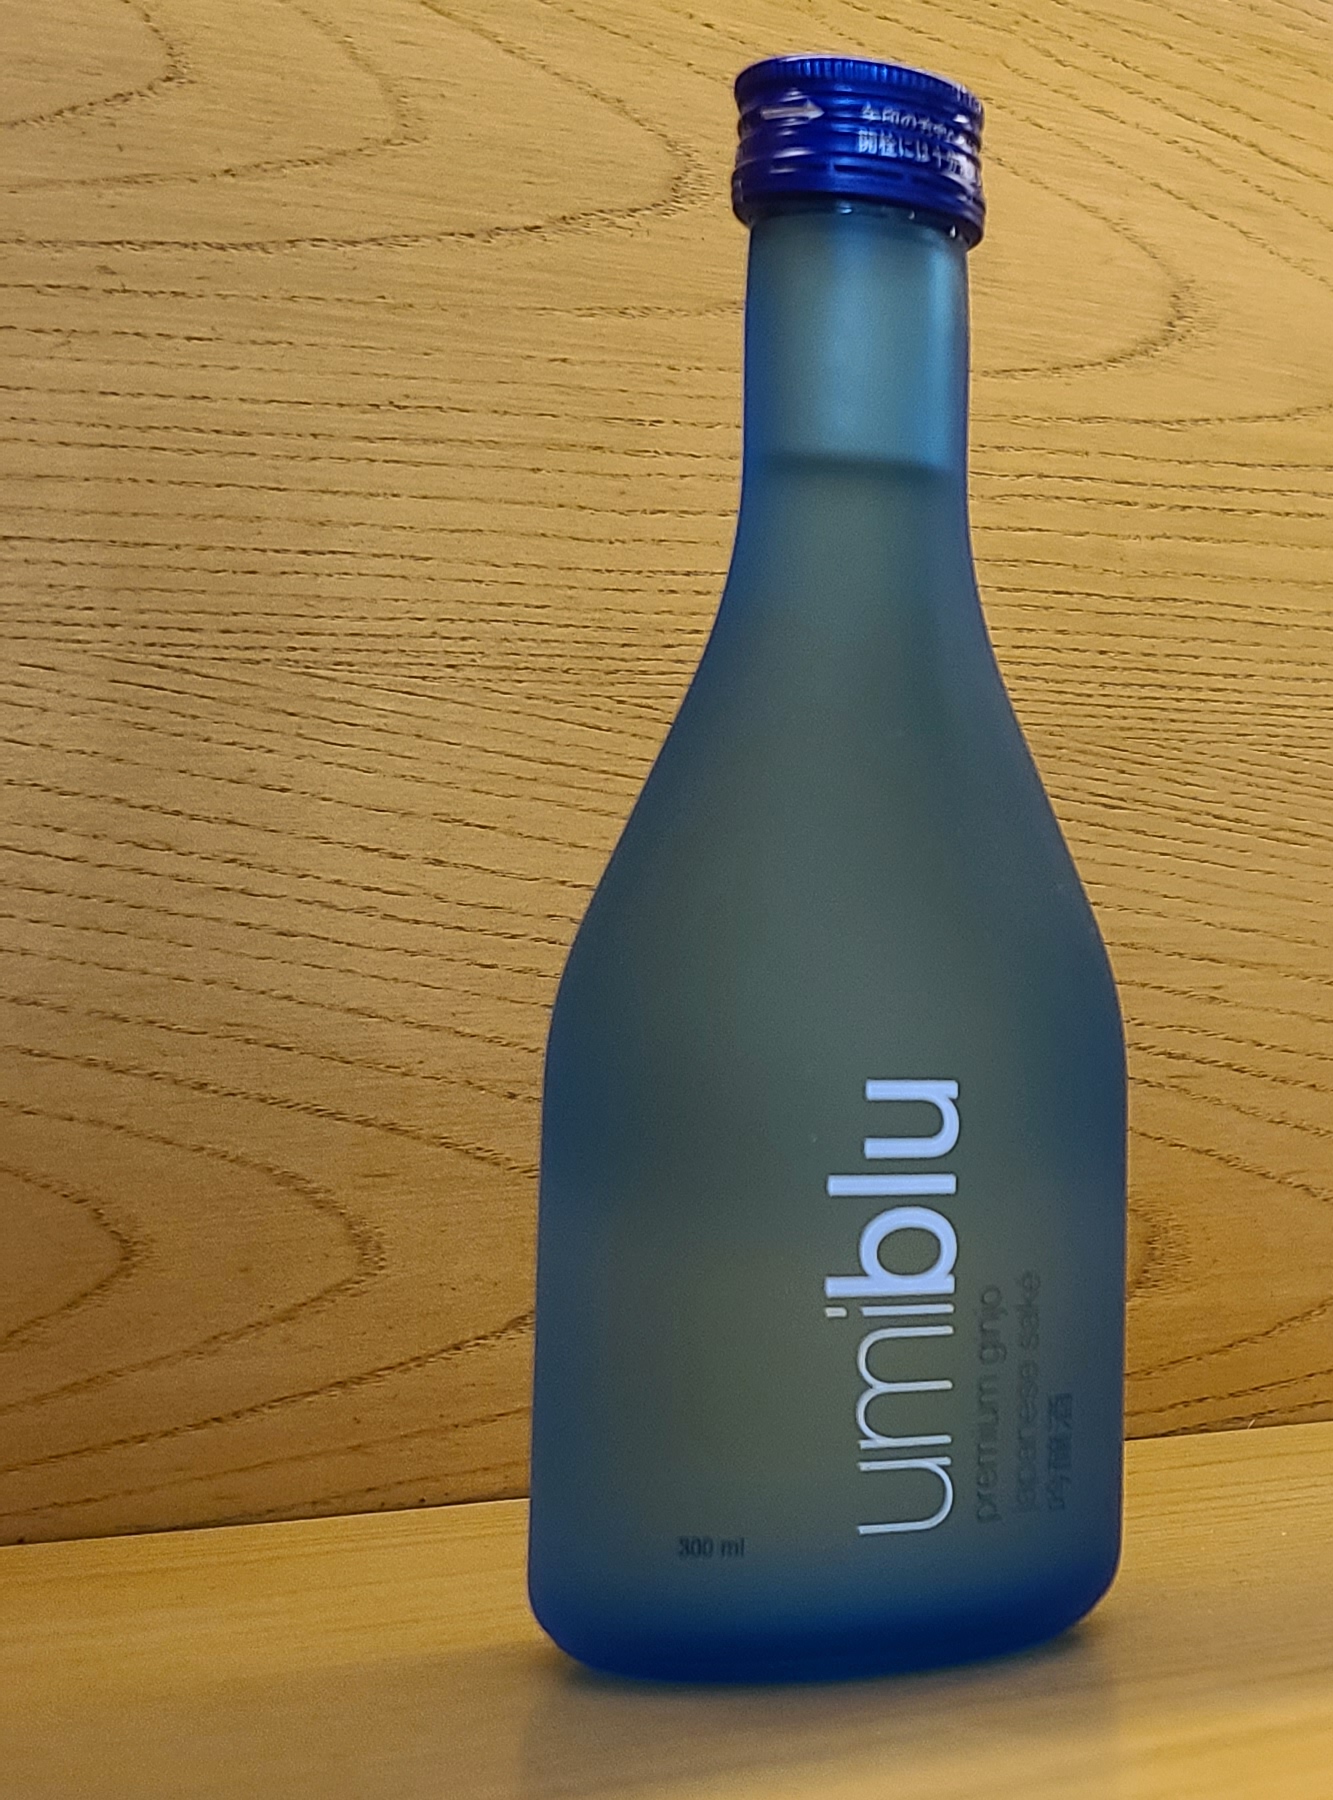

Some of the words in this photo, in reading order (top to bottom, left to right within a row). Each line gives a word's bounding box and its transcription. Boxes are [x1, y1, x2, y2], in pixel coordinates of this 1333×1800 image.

[825, 1079, 960, 1535] umiblu
[974, 1375, 1003, 1524] premium
[677, 1536, 715, 1560] 300
[720, 1537, 746, 1558] ml
